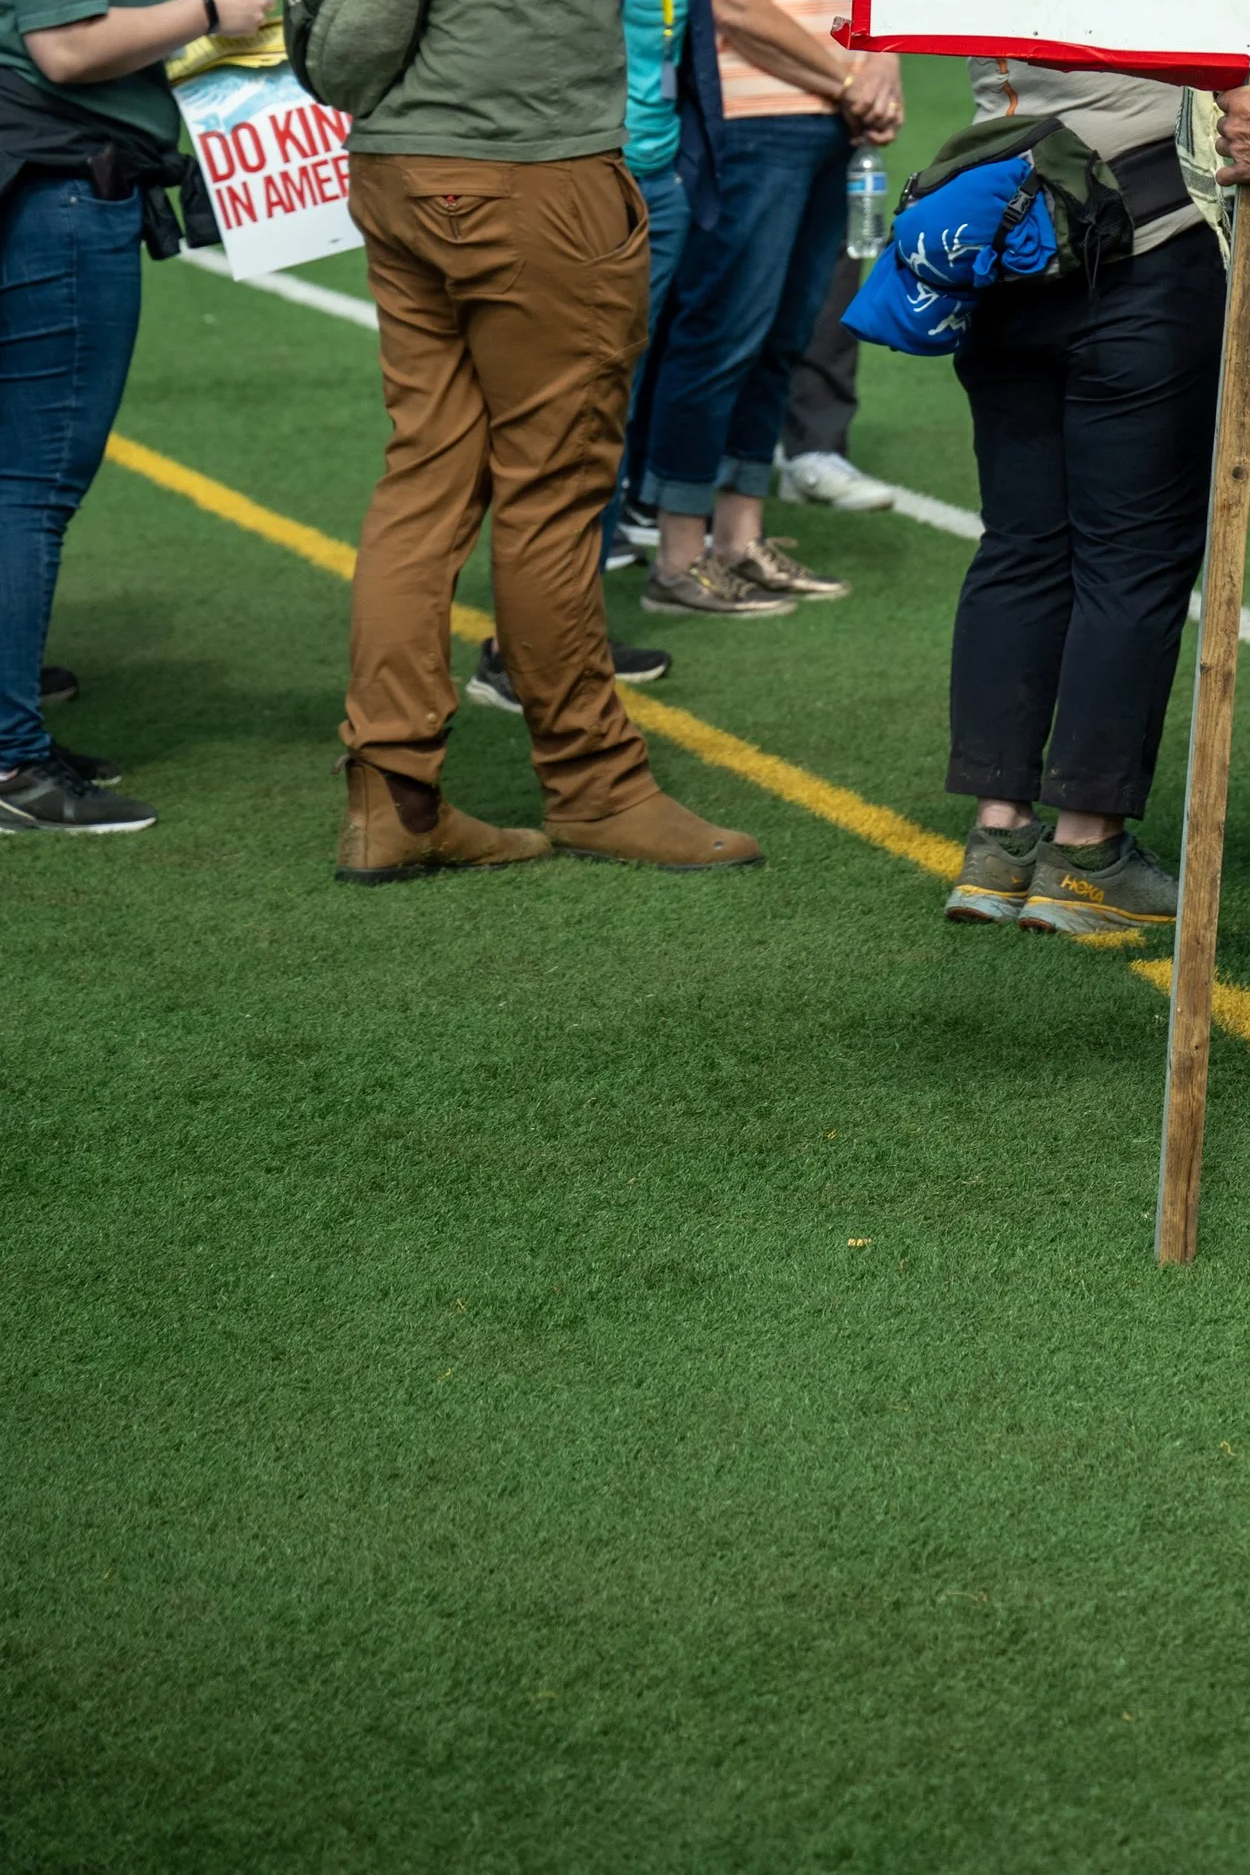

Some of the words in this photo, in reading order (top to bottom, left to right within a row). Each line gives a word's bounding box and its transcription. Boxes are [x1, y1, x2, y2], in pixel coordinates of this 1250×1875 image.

[198, 121, 267, 183] DO
[215, 181, 258, 230] IN
[1059, 874, 1105, 903] HOKA
